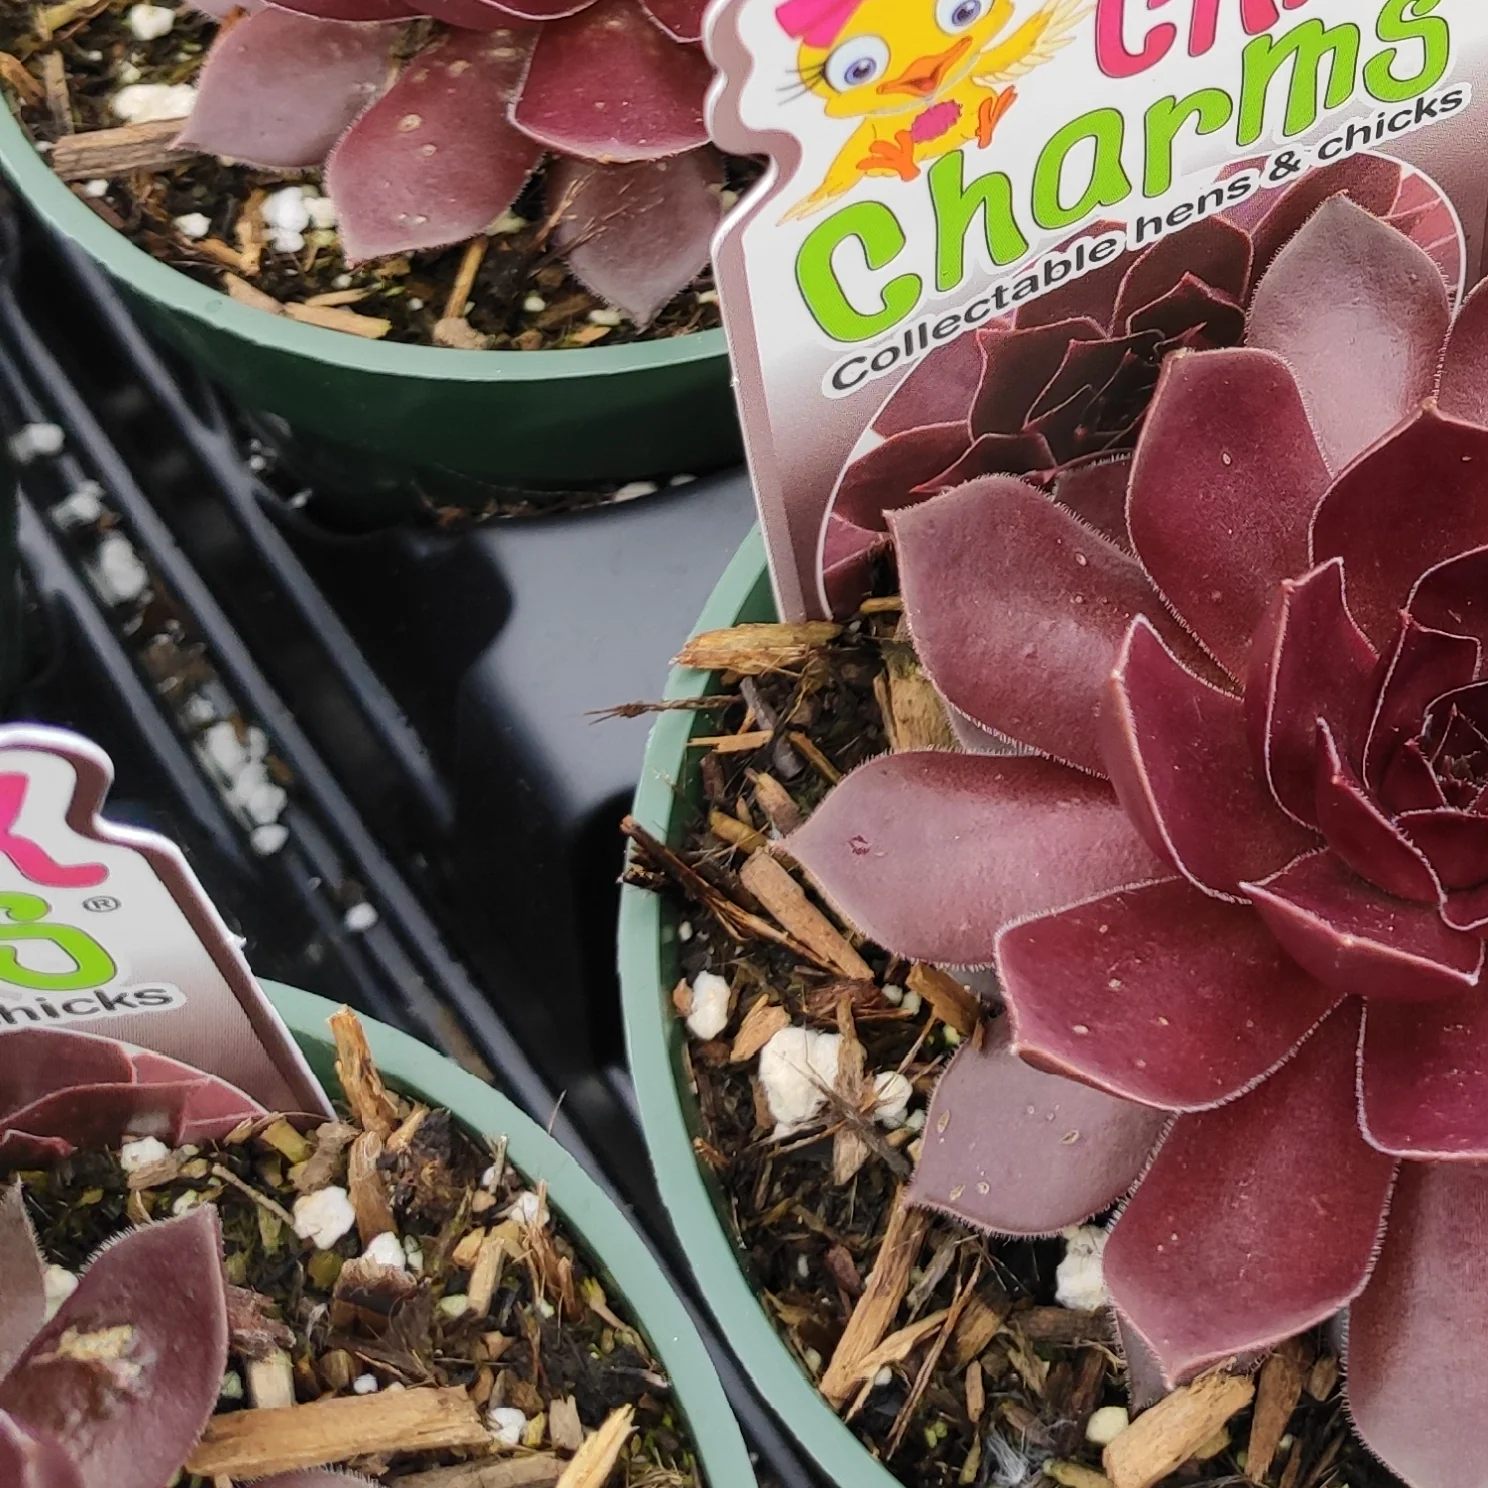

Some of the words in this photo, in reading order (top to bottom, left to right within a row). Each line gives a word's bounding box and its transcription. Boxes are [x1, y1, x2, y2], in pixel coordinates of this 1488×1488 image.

[830, 232, 1119, 392] Collectable
[1135, 173, 1252, 237] hens
[1268, 150, 1304, 180] &
[1317, 85, 1464, 160] chicks
[0, 987, 174, 1025] hicks
